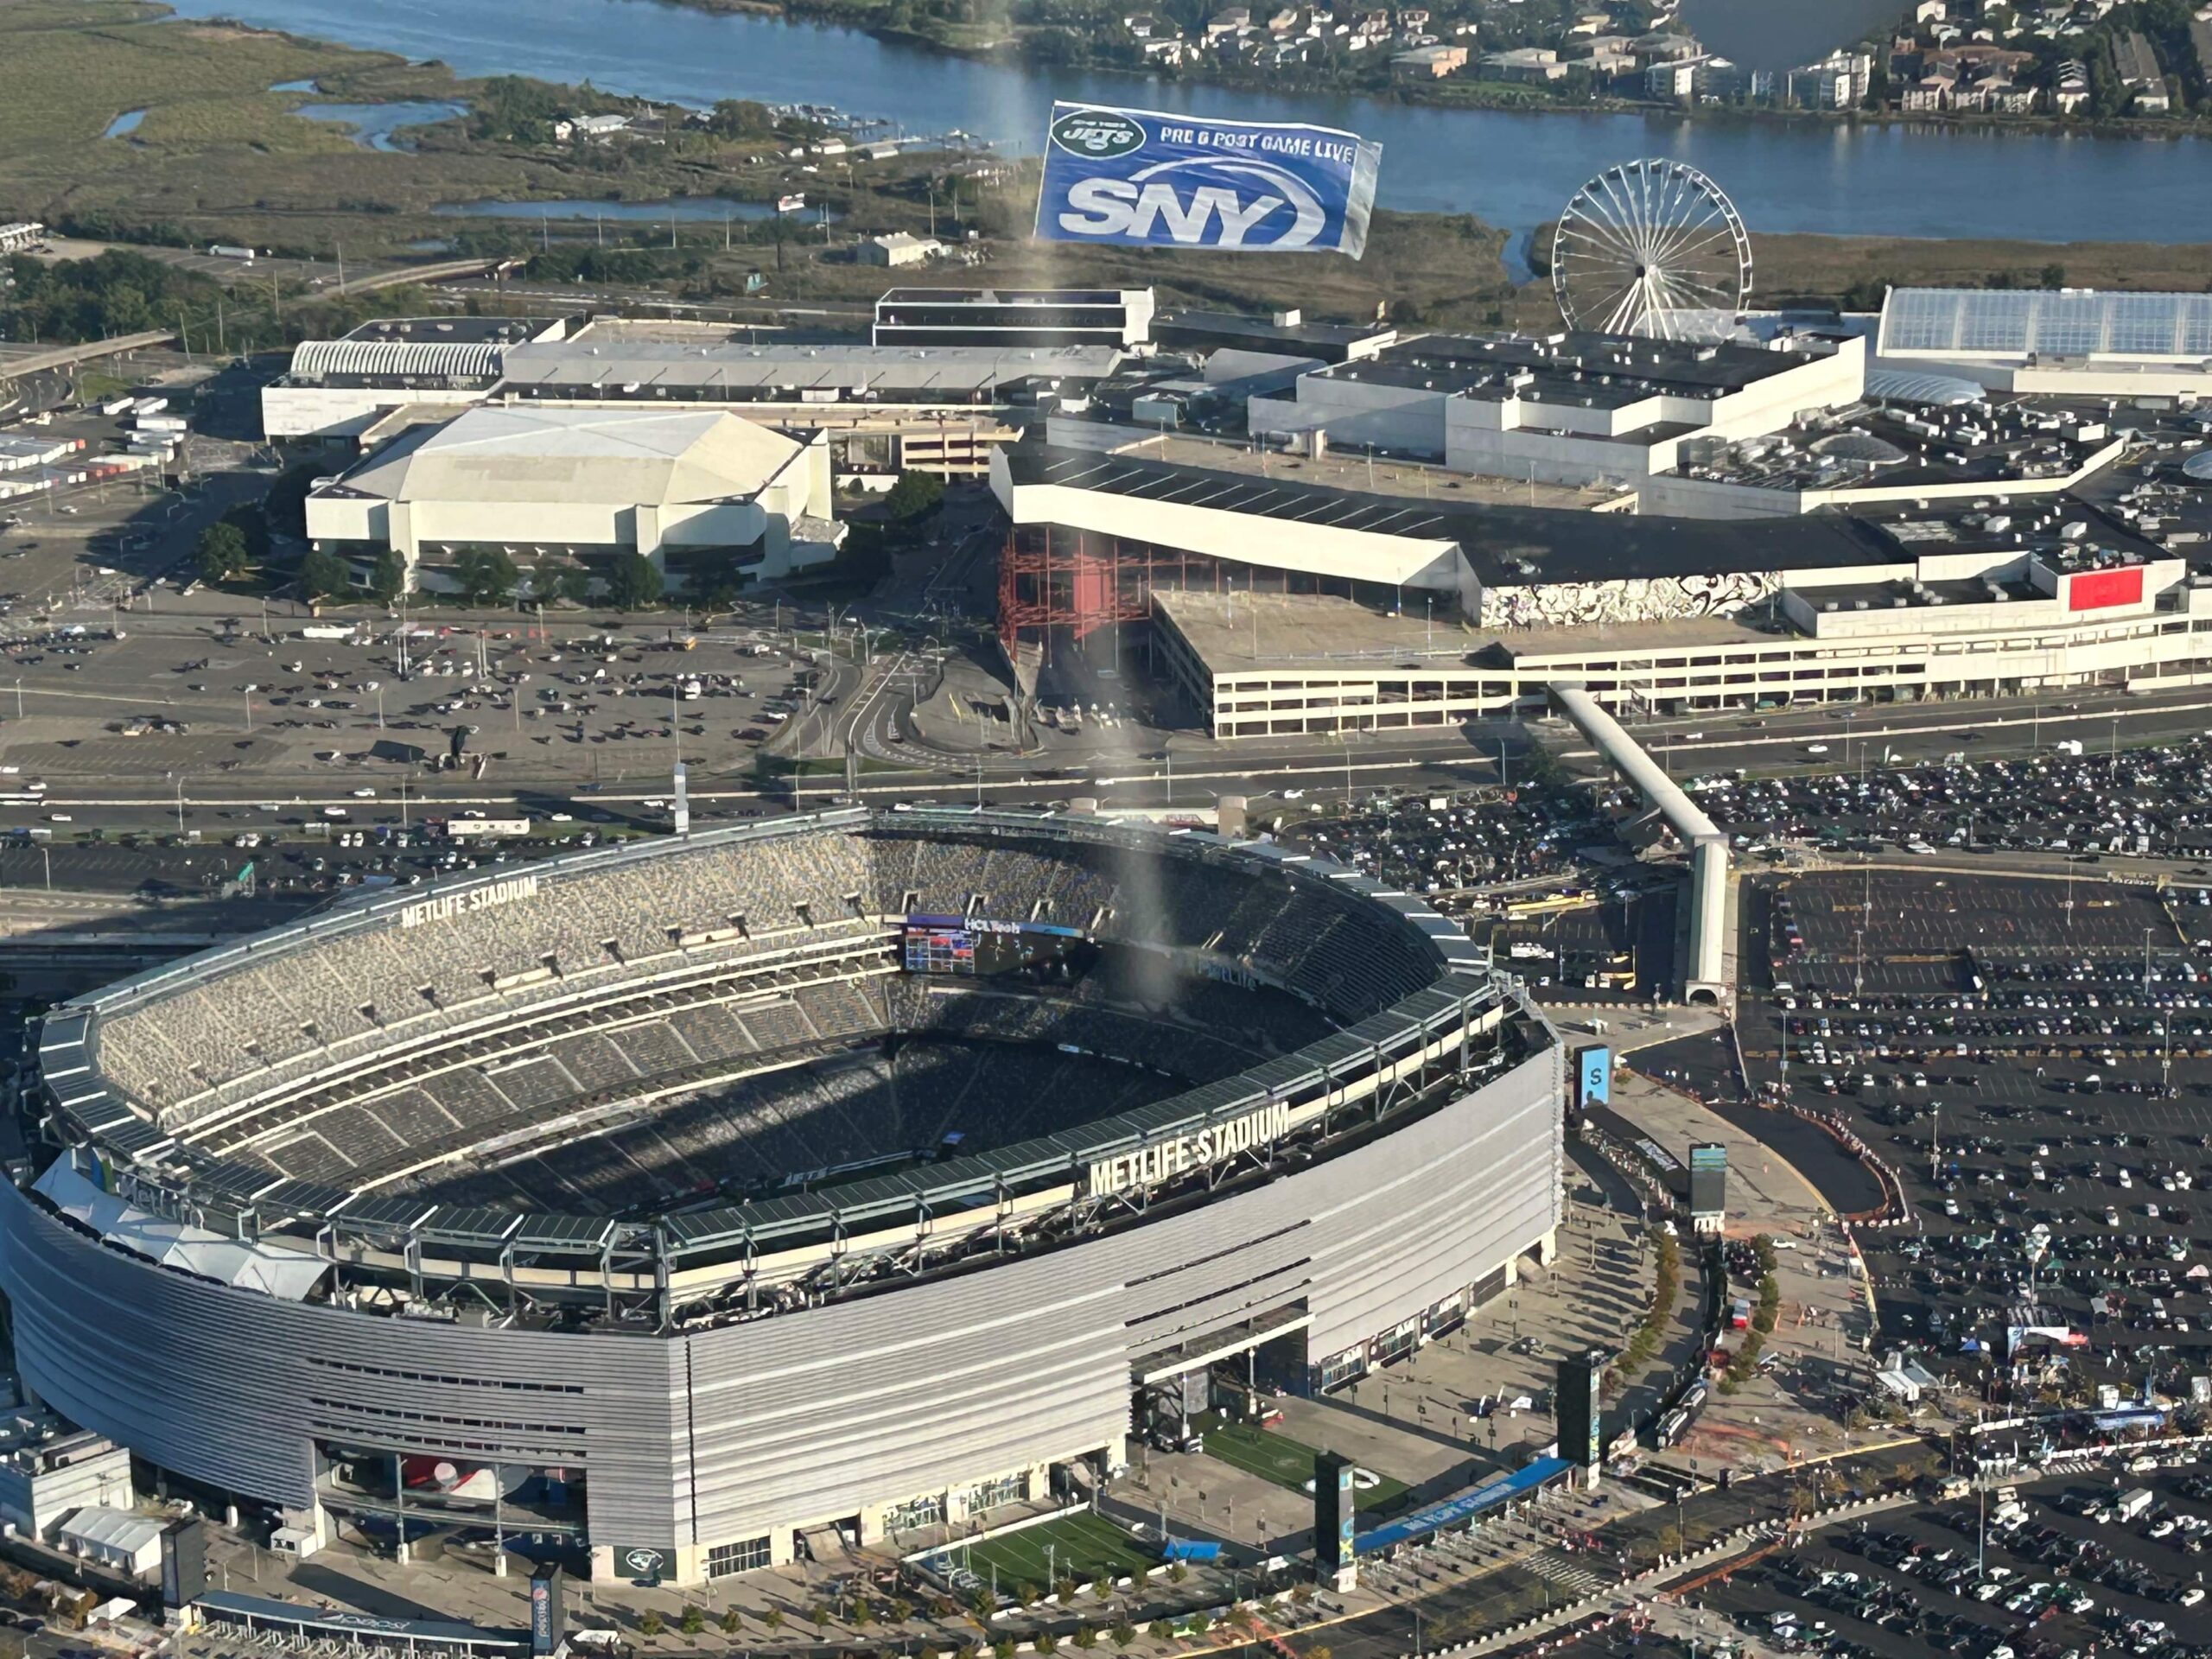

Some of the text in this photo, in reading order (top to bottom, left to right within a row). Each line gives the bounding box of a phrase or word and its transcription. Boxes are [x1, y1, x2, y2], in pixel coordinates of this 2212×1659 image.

[1160, 127, 1193, 143] PRE
[1212, 132, 1259, 148] POST
[1261, 136, 1311, 156] GAME
[1314, 140, 1353, 162] LIVE
[1059, 178, 1284, 246] SNY
[402, 875, 537, 928] METLIFE STADIUM
[1090, 1101, 1289, 1198] METLIFE STADIUM
